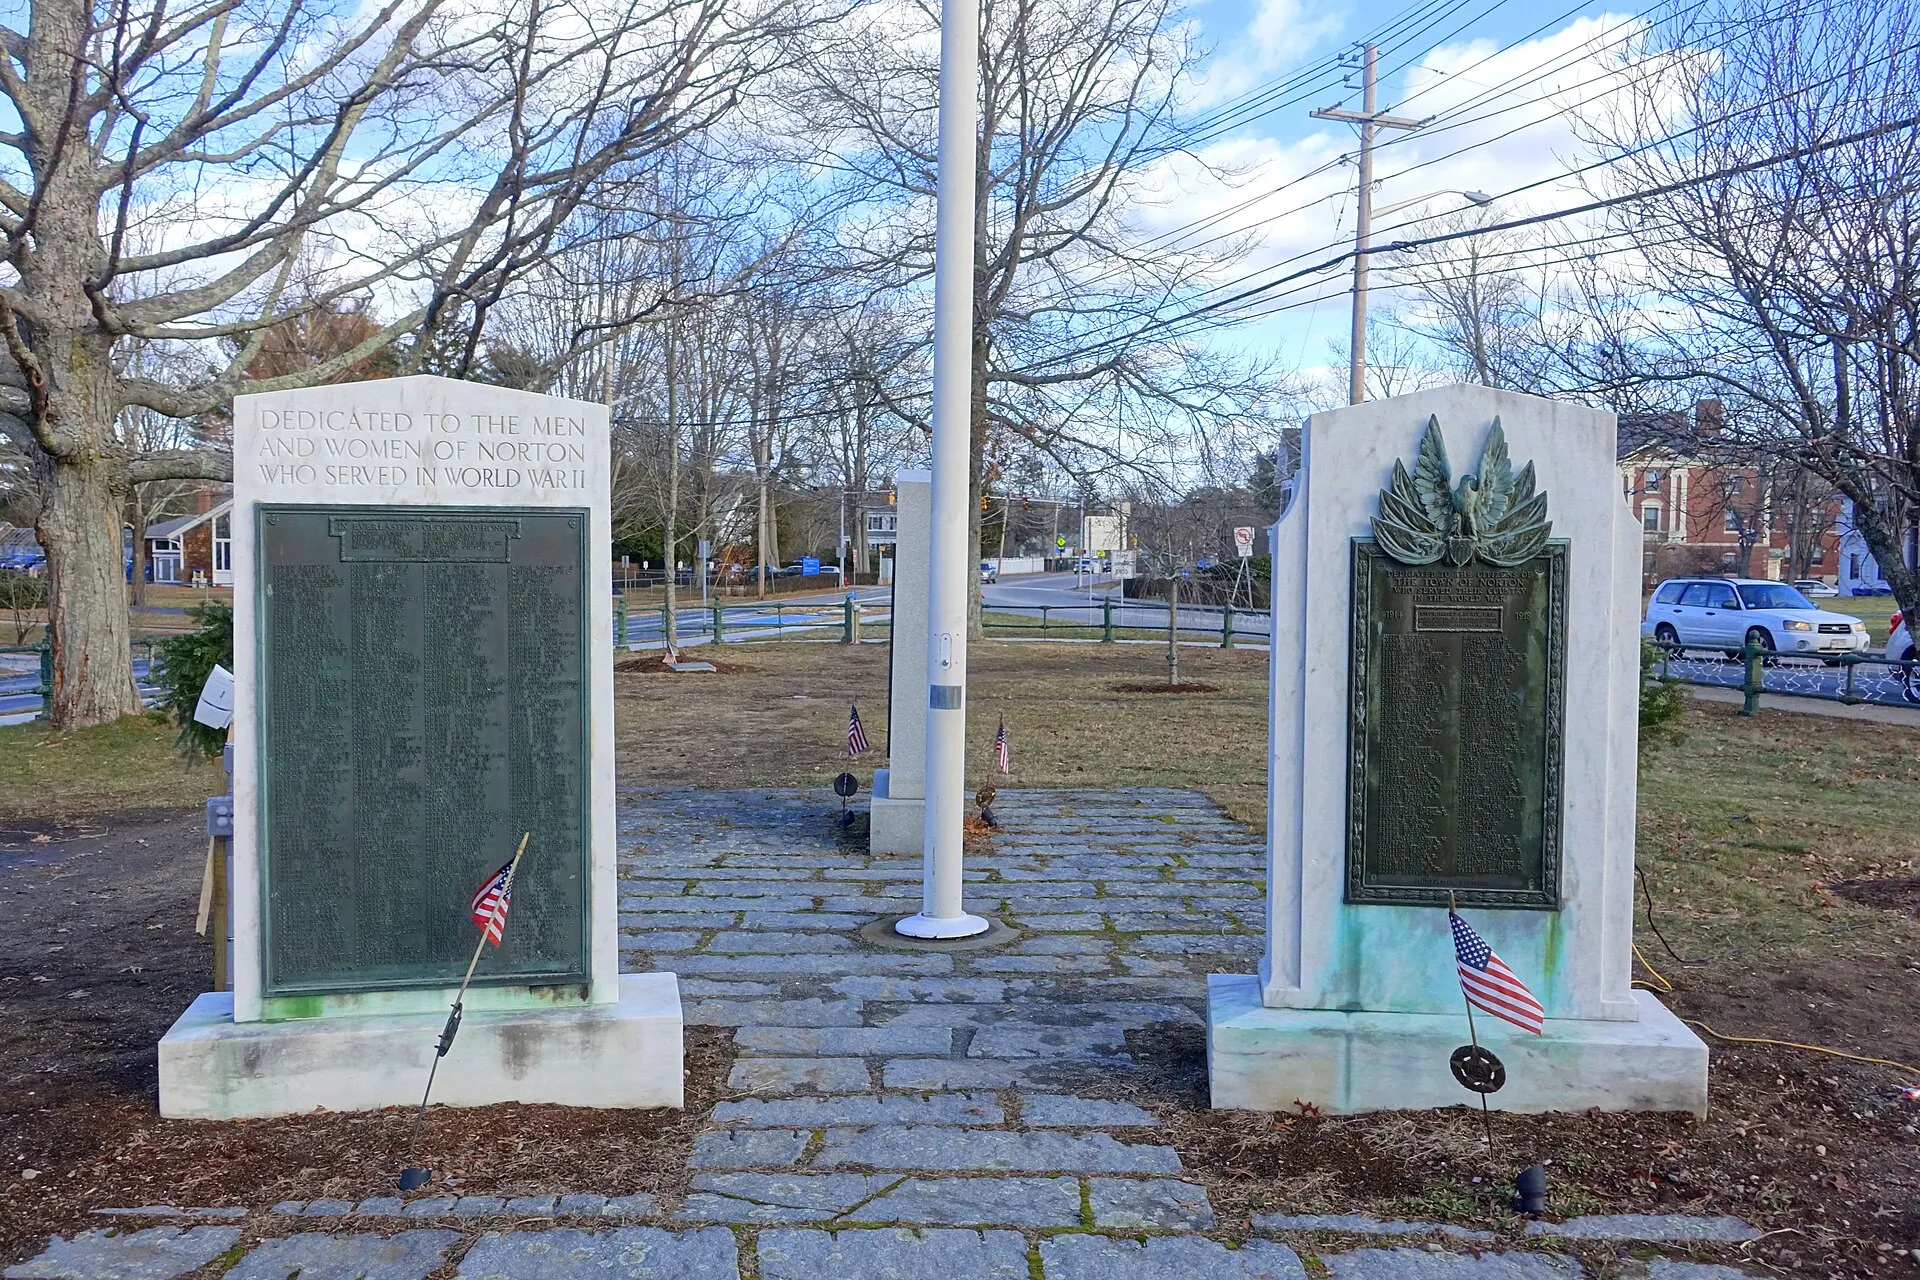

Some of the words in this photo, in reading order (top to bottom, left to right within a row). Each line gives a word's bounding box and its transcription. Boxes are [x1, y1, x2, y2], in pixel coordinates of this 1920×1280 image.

[261, 409, 413, 432] DEDICATED
[423, 413, 460, 434] TO
[471, 415, 520, 436] THE
[533, 416, 585, 437] MEN
[259, 437, 315, 458] AND
[324, 438, 421, 460] WOMEN
[433, 440, 467, 461] OF
[478, 441, 585, 463] NORTON
[259, 464, 317, 485] WHO
[325, 465, 407, 487] SERVED
[416, 467, 436, 487] IN
[445, 467, 521, 488] WORLD
[527, 469, 568, 489] WAR
[573, 470, 585, 489] II
[352, 523, 418, 531] EVERLASTING
[422, 524, 454, 532] GLORY
[1393, 586, 1413, 594] WHO
[1487, 587, 1527, 595] COUNTRY
[1395, 577, 1417, 586] THE
[1424, 577, 1454, 587] TOWN
[1459, 578, 1473, 587] OF
[1480, 578, 1525, 588] NORTON
